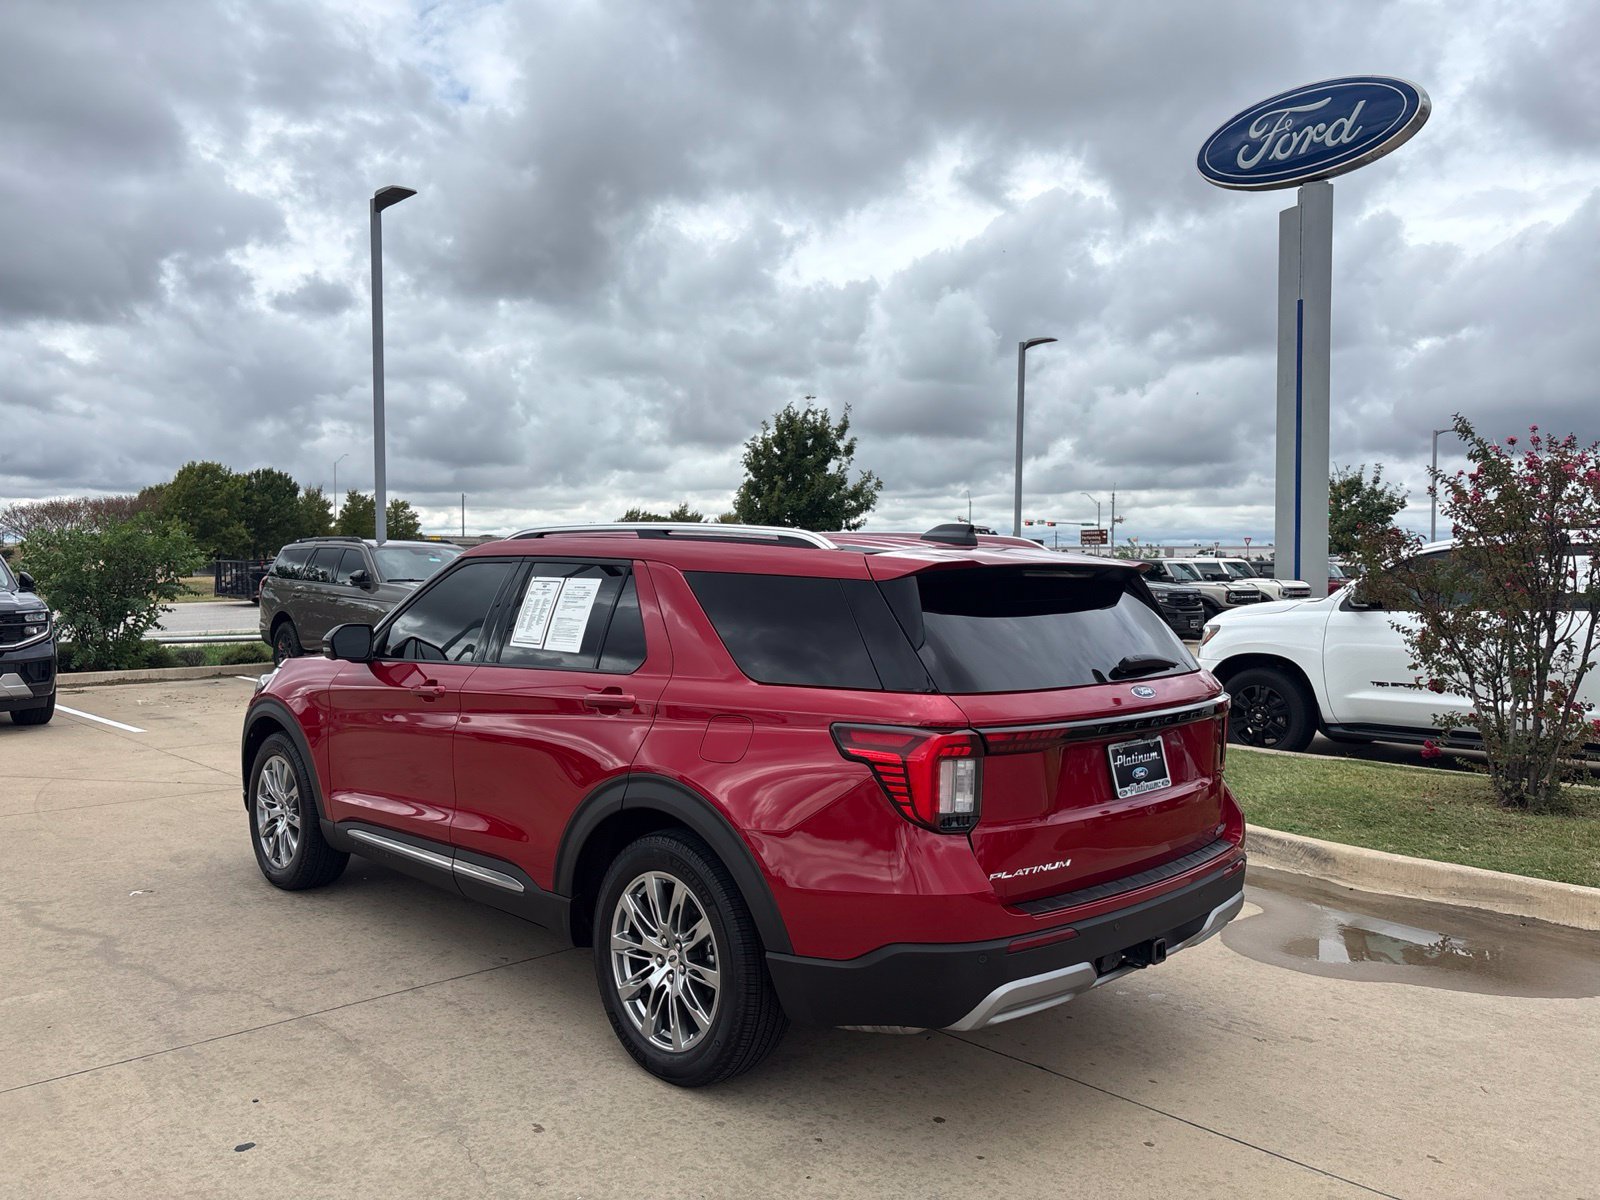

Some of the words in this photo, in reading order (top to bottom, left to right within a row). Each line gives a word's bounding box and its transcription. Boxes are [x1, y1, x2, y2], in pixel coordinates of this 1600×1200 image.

[1236, 97, 1366, 170] Ford
[1114, 751, 1161, 768] Platinum
[1129, 782, 1161, 795] Platinum
[989, 859, 1072, 882] PLATINUM
